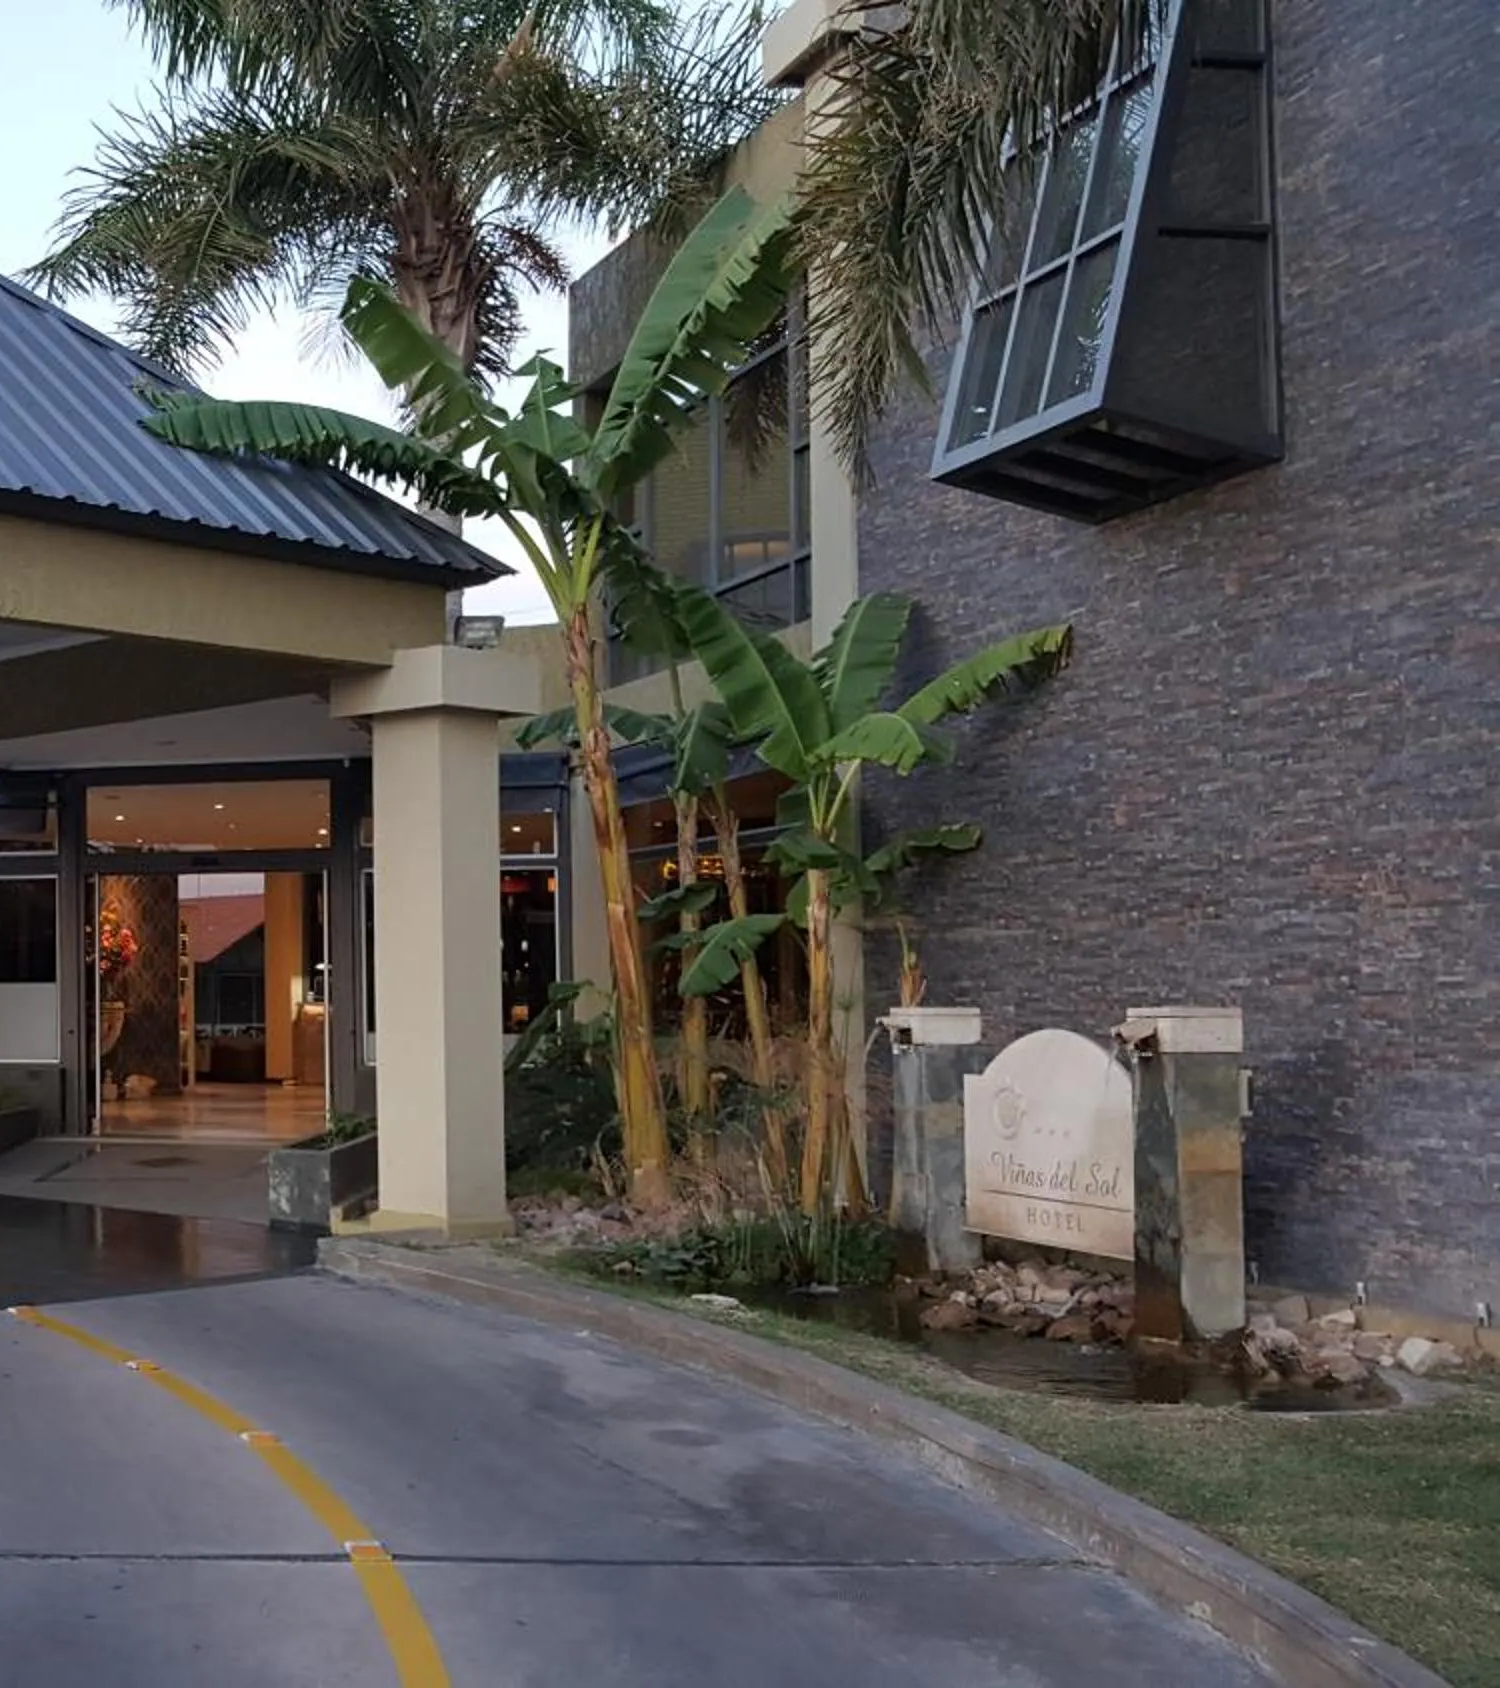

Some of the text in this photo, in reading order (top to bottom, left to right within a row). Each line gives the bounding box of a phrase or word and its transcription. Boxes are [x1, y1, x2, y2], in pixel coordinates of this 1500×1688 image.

[990, 1150, 1122, 1200] Viñas del Sol
[1026, 1206, 1085, 1233] HOTEL
